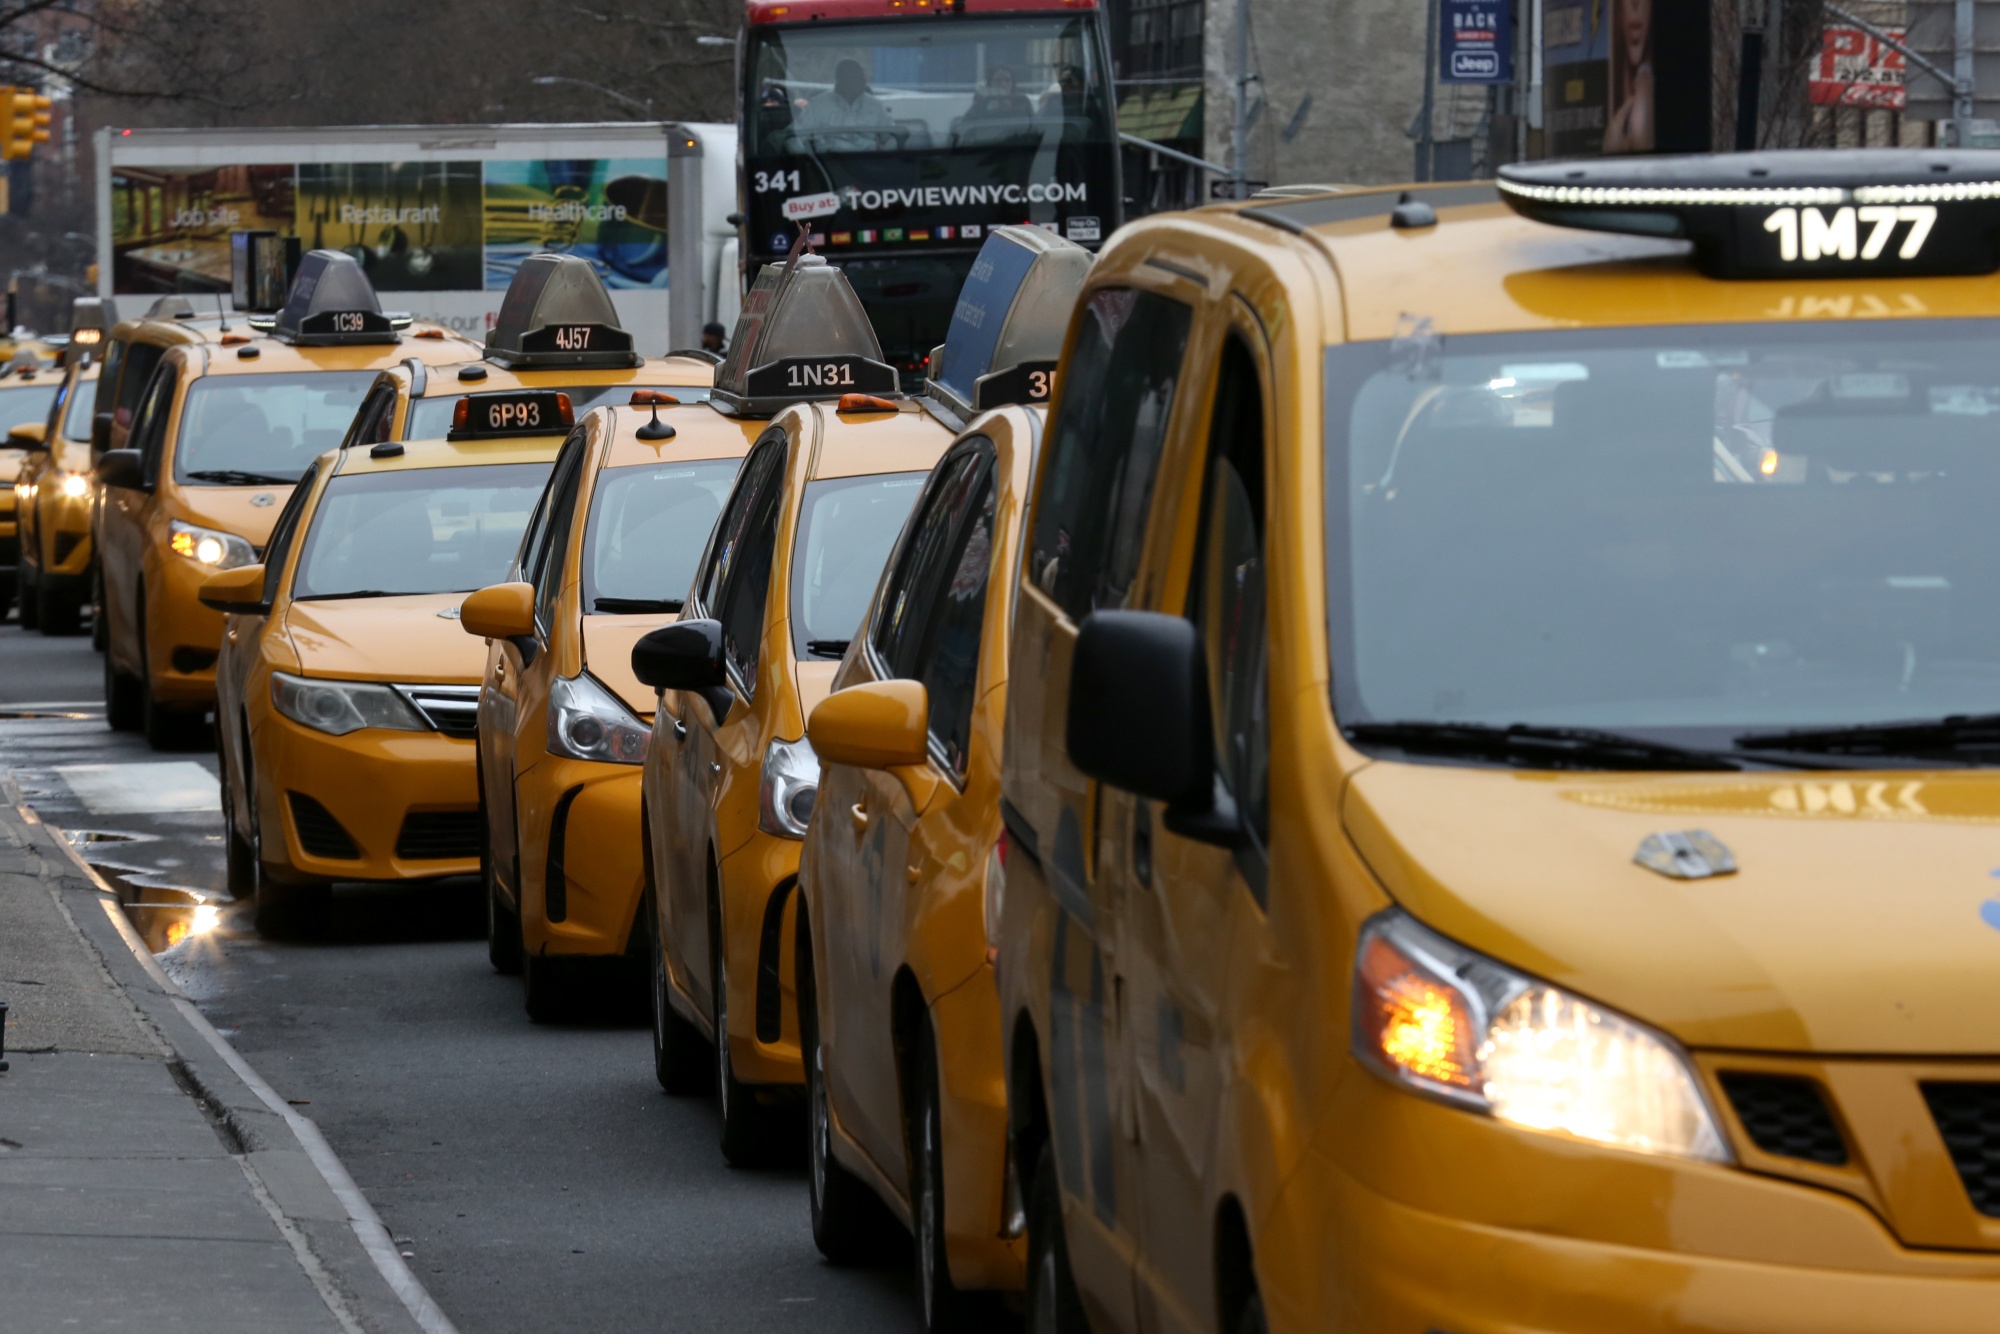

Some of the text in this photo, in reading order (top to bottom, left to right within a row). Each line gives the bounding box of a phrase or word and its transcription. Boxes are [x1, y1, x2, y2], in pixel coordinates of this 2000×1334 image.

[1453, 13, 1497, 28] BACK
[1457, 57, 1493, 71] Jeep
[754, 170, 800, 193] 341
[788, 198, 836, 213] Buy at:
[848, 182, 1087, 211] TOPVIEWNYC.COM
[169, 206, 241, 228] Job site
[340, 203, 441, 224] Restaurant
[528, 202, 627, 222] Healthcare
[1763, 205, 1938, 262] 1M77
[332, 312, 364, 331] 1C39
[451, 315, 480, 331] our
[556, 327, 591, 349] 4J57
[787, 363, 854, 387] 1N31
[489, 402, 540, 427] 6P93
